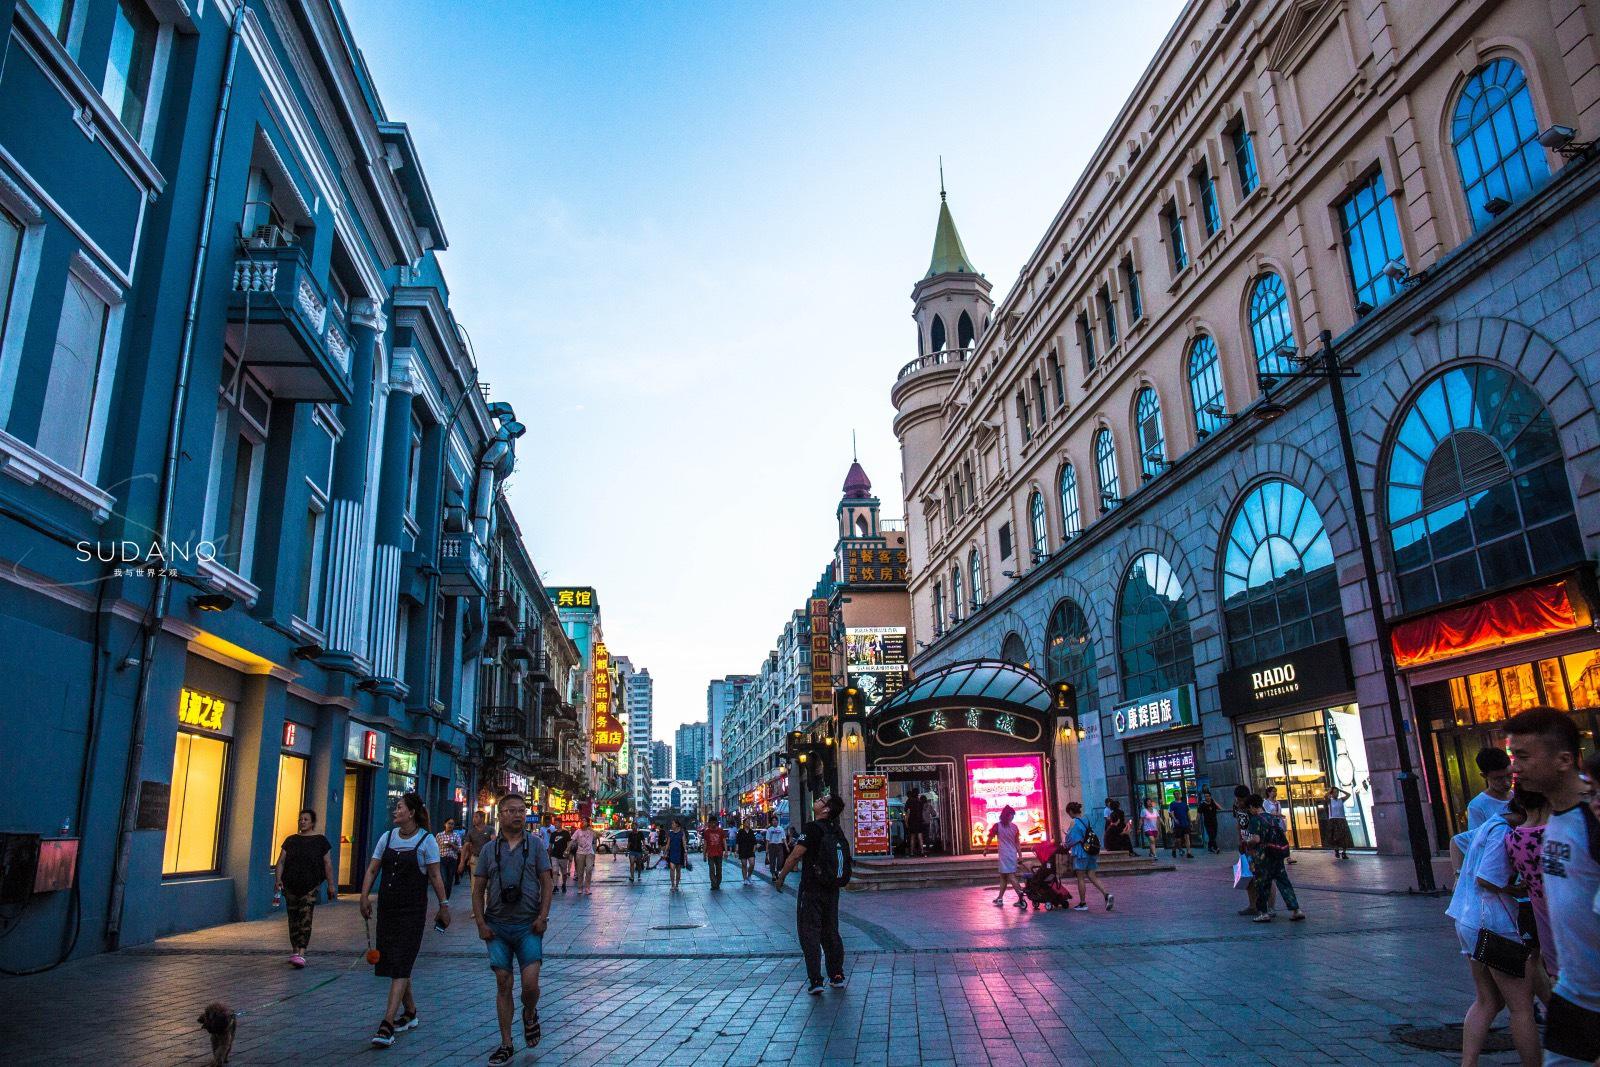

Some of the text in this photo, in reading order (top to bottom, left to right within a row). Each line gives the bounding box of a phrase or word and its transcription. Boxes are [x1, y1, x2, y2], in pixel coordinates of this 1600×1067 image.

[558, 590, 591, 606] 宾馆
[1251, 664, 1296, 690] RADO
[1255, 683, 1299, 700] SWITZERLAND
[1128, 698, 1173, 730] 康辉国旅
[595, 731, 622, 744] 酒店
